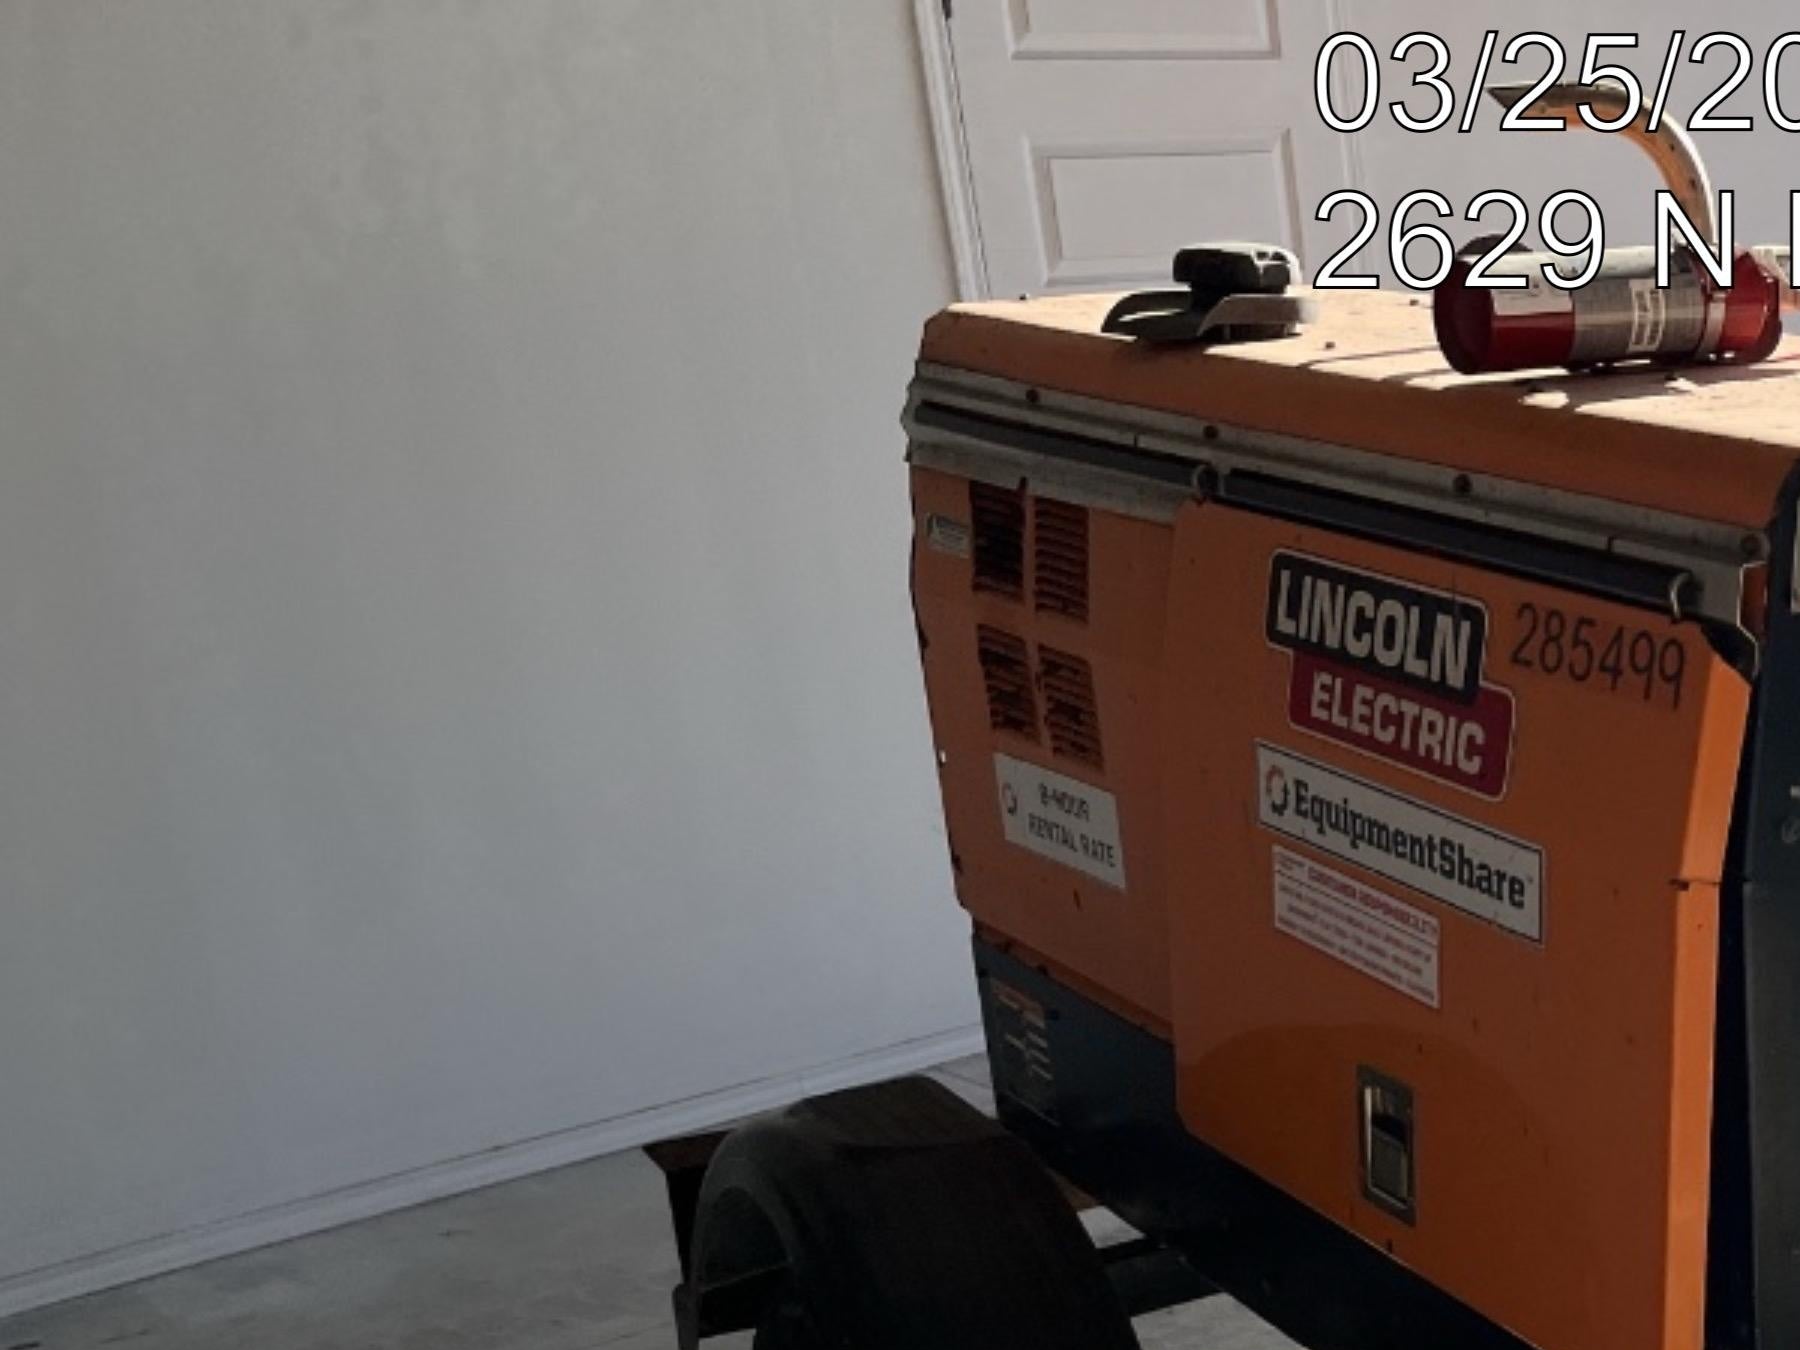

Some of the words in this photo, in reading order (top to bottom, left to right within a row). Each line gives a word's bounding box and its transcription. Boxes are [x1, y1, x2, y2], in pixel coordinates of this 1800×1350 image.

[1275, 569, 1472, 689] LINCOLN
[1510, 602, 1686, 711] 285499
[1310, 671, 1486, 776] ELECTRIC
[1293, 778, 1526, 910] EquipmentShare
